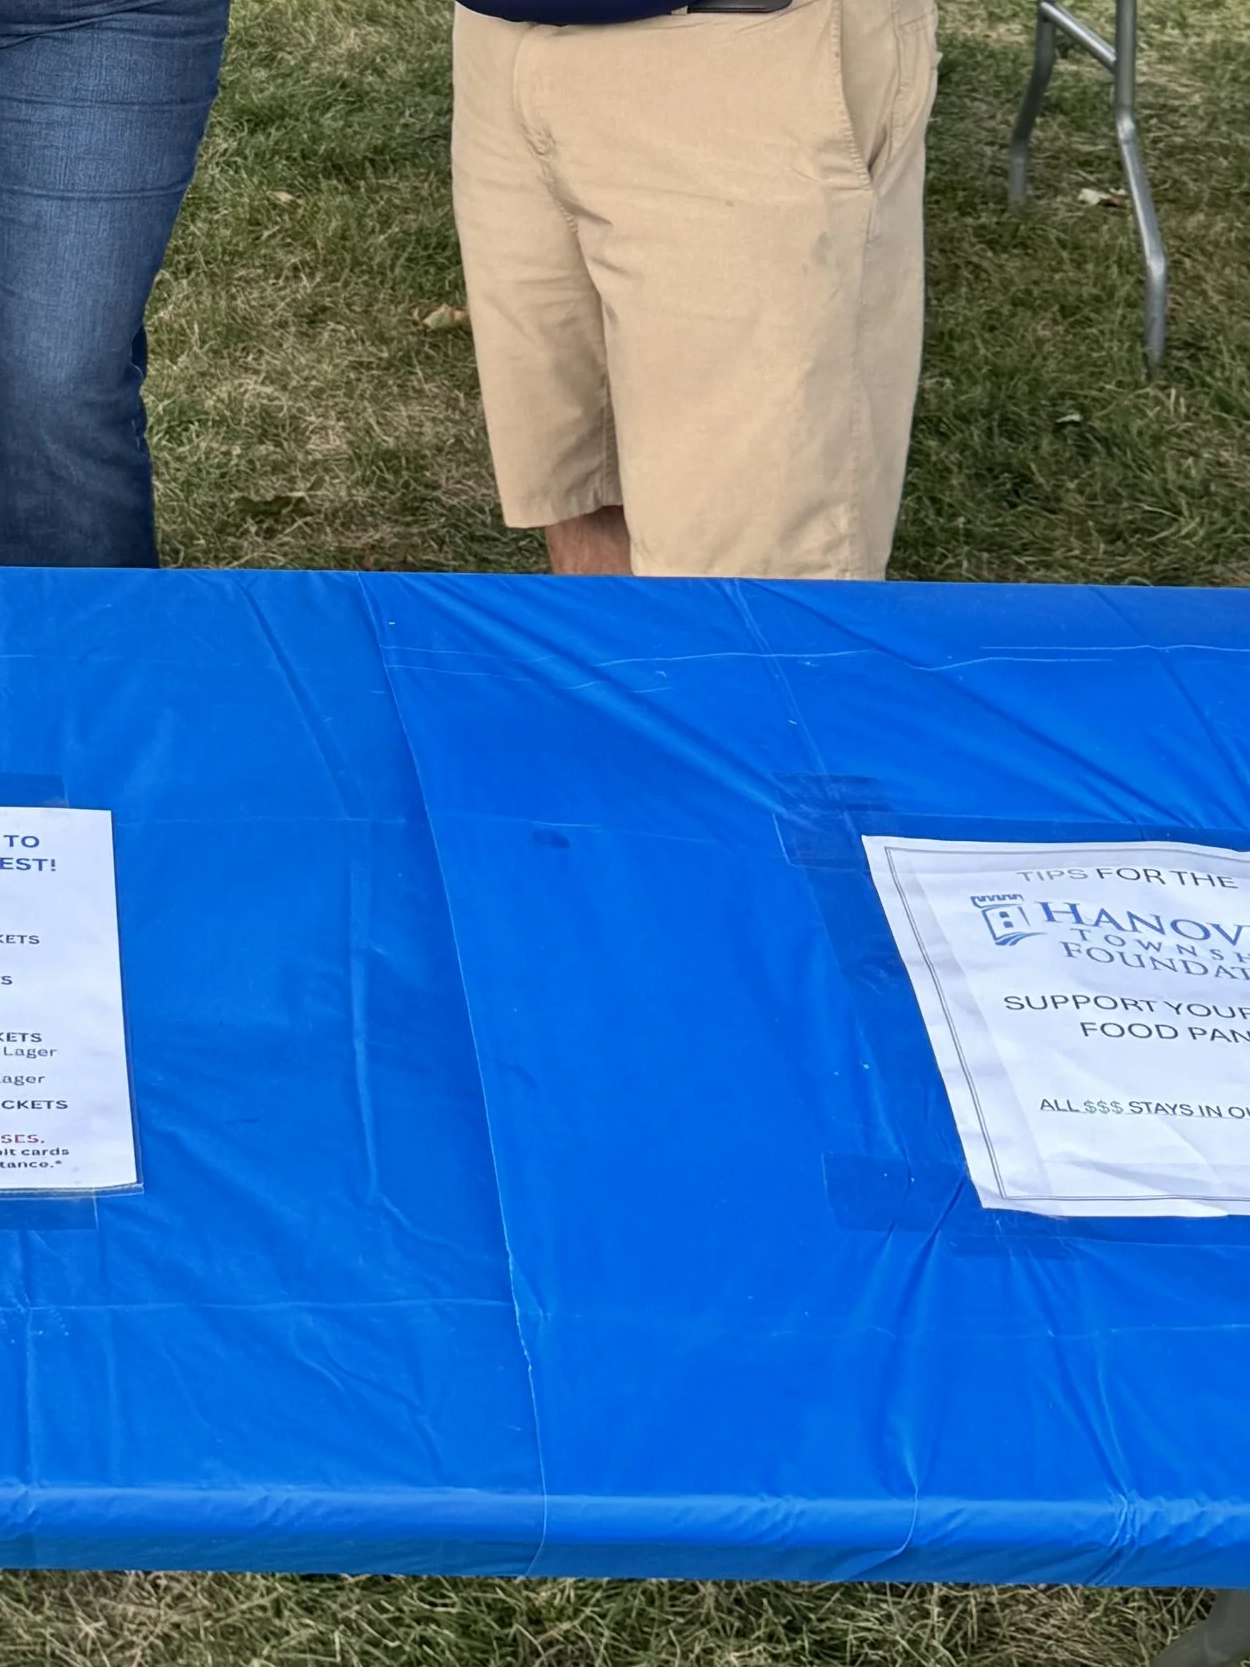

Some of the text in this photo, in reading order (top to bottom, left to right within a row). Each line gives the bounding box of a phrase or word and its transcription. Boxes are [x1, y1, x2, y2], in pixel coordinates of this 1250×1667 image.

[3, 833, 40, 848] TO
[1016, 867, 1240, 889] TIPS FOR THE
[1004, 994, 1160, 1013] SUPPORT
[1080, 1021, 1179, 1040] FOOD
[3, 1046, 58, 1059] Lager
[1040, 1098, 1223, 1118] ALL $$$ STAYS IN
[21, 1147, 70, 1156] cards
